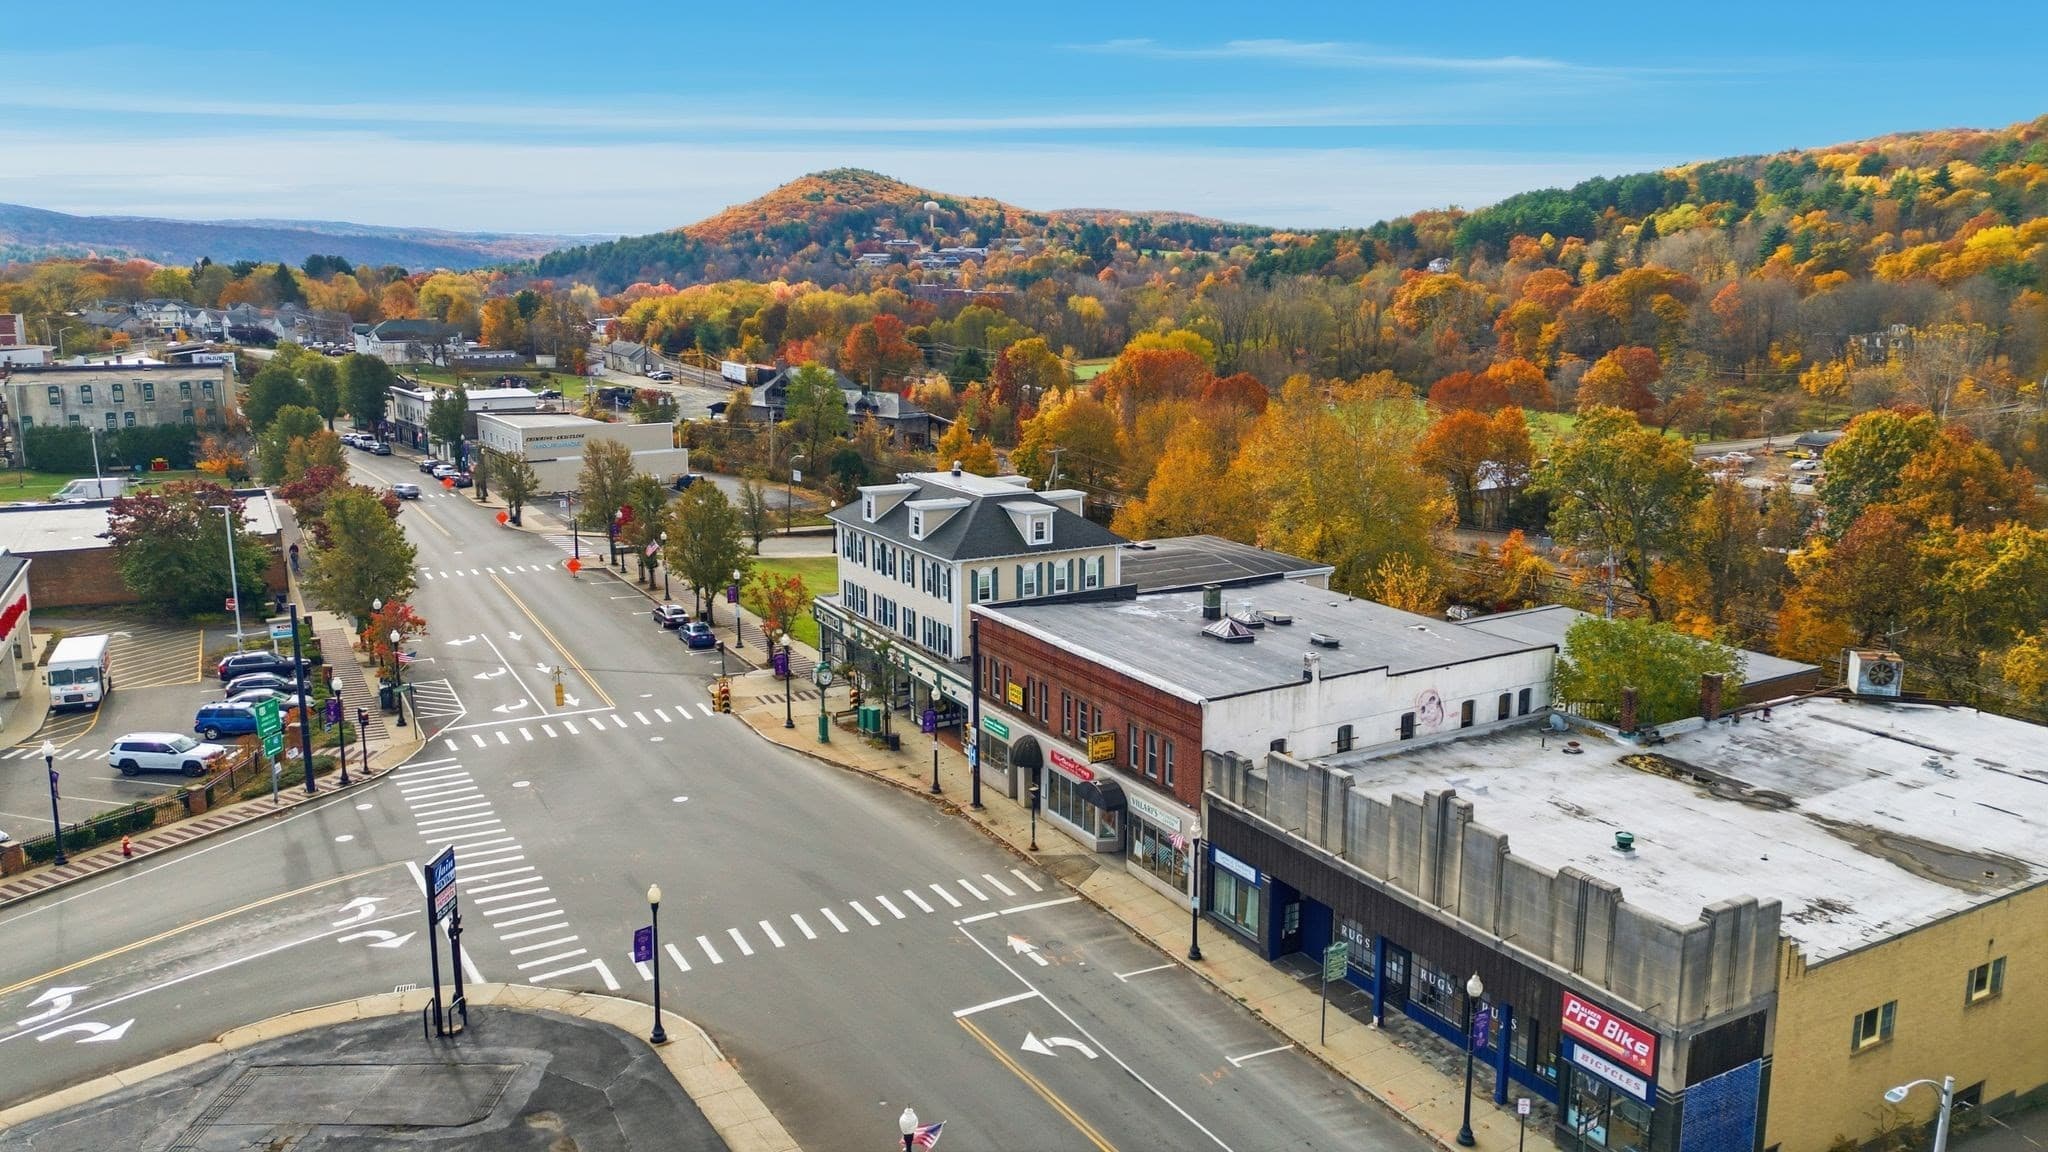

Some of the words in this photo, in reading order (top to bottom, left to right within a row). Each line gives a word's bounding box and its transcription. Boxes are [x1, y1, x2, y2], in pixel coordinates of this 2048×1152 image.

[1341, 924, 1370, 948] RUGS
[1420, 968, 1453, 994] RUGS
[1482, 1002, 1517, 1030] RUS
[1565, 999, 1600, 1030] Pro
[1602, 1019, 1650, 1057] Bike
[1580, 1053, 1641, 1090] BICYCLES
